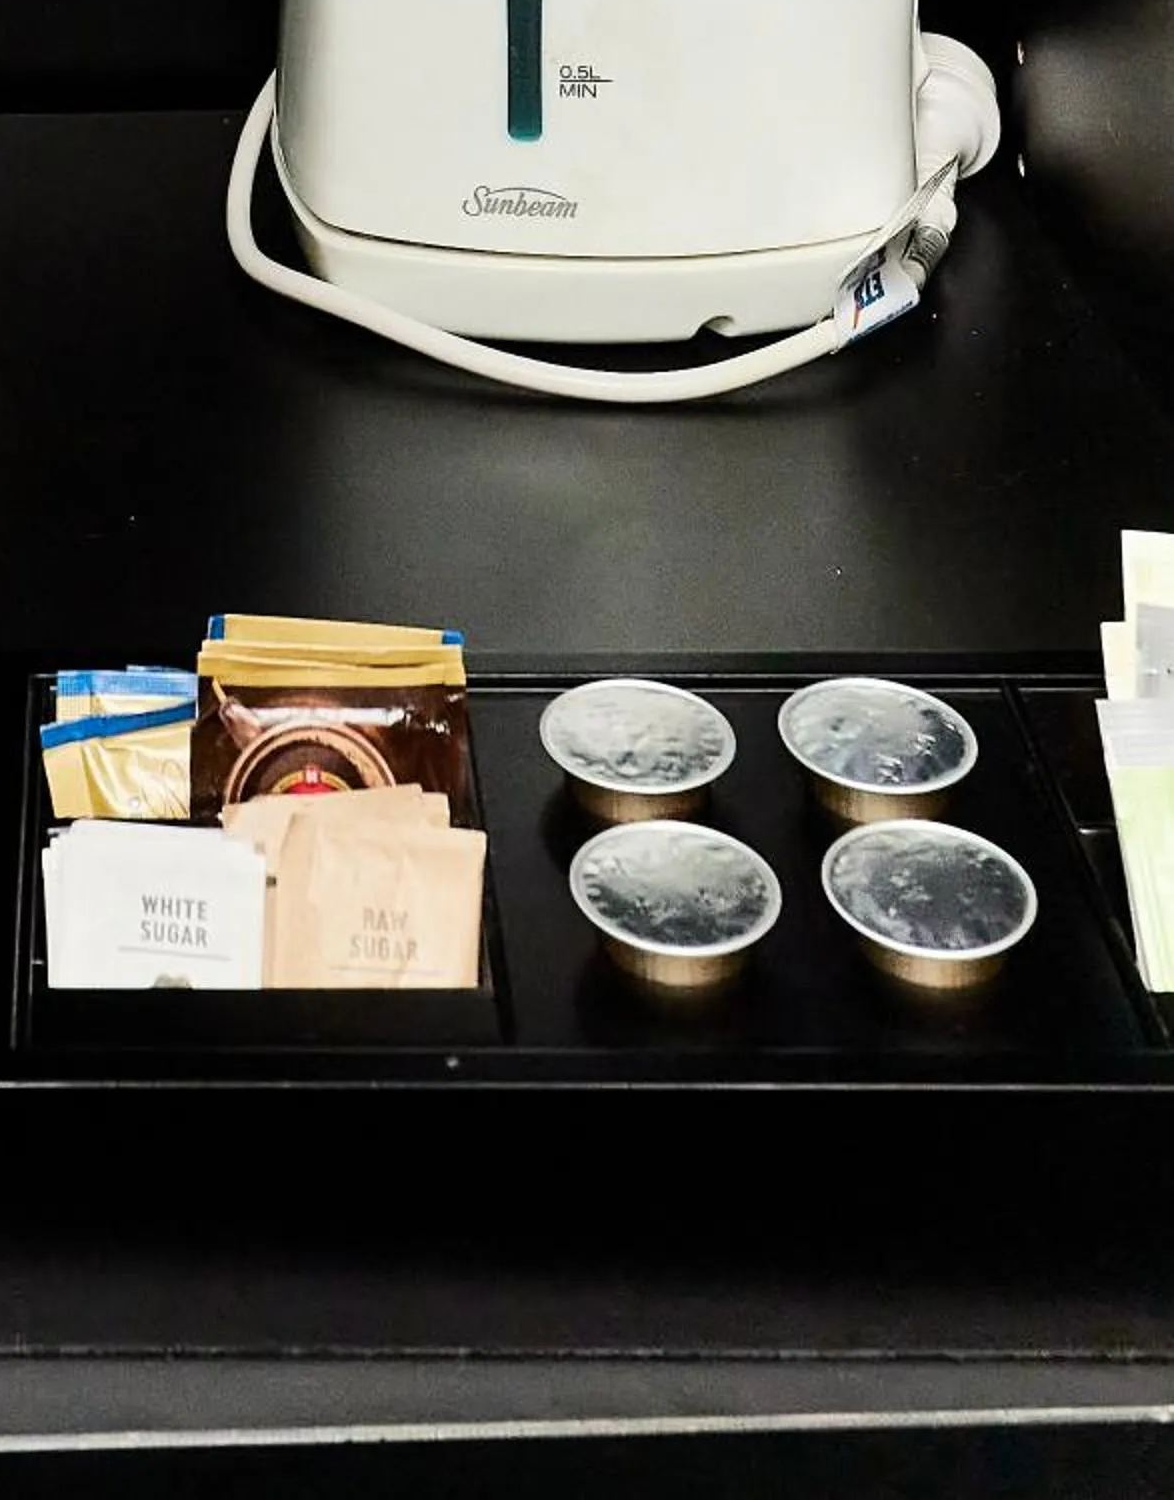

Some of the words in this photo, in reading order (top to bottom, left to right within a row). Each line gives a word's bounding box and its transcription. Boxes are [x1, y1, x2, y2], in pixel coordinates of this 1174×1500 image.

[559, 65, 601, 79] 0.5L
[559, 83, 597, 98] MIN
[462, 185, 578, 218] Sunbeam
[141, 894, 208, 921] WHITE
[363, 906, 409, 931] RAW
[140, 919, 208, 948] SUGAR
[348, 933, 420, 961] SUGAR
